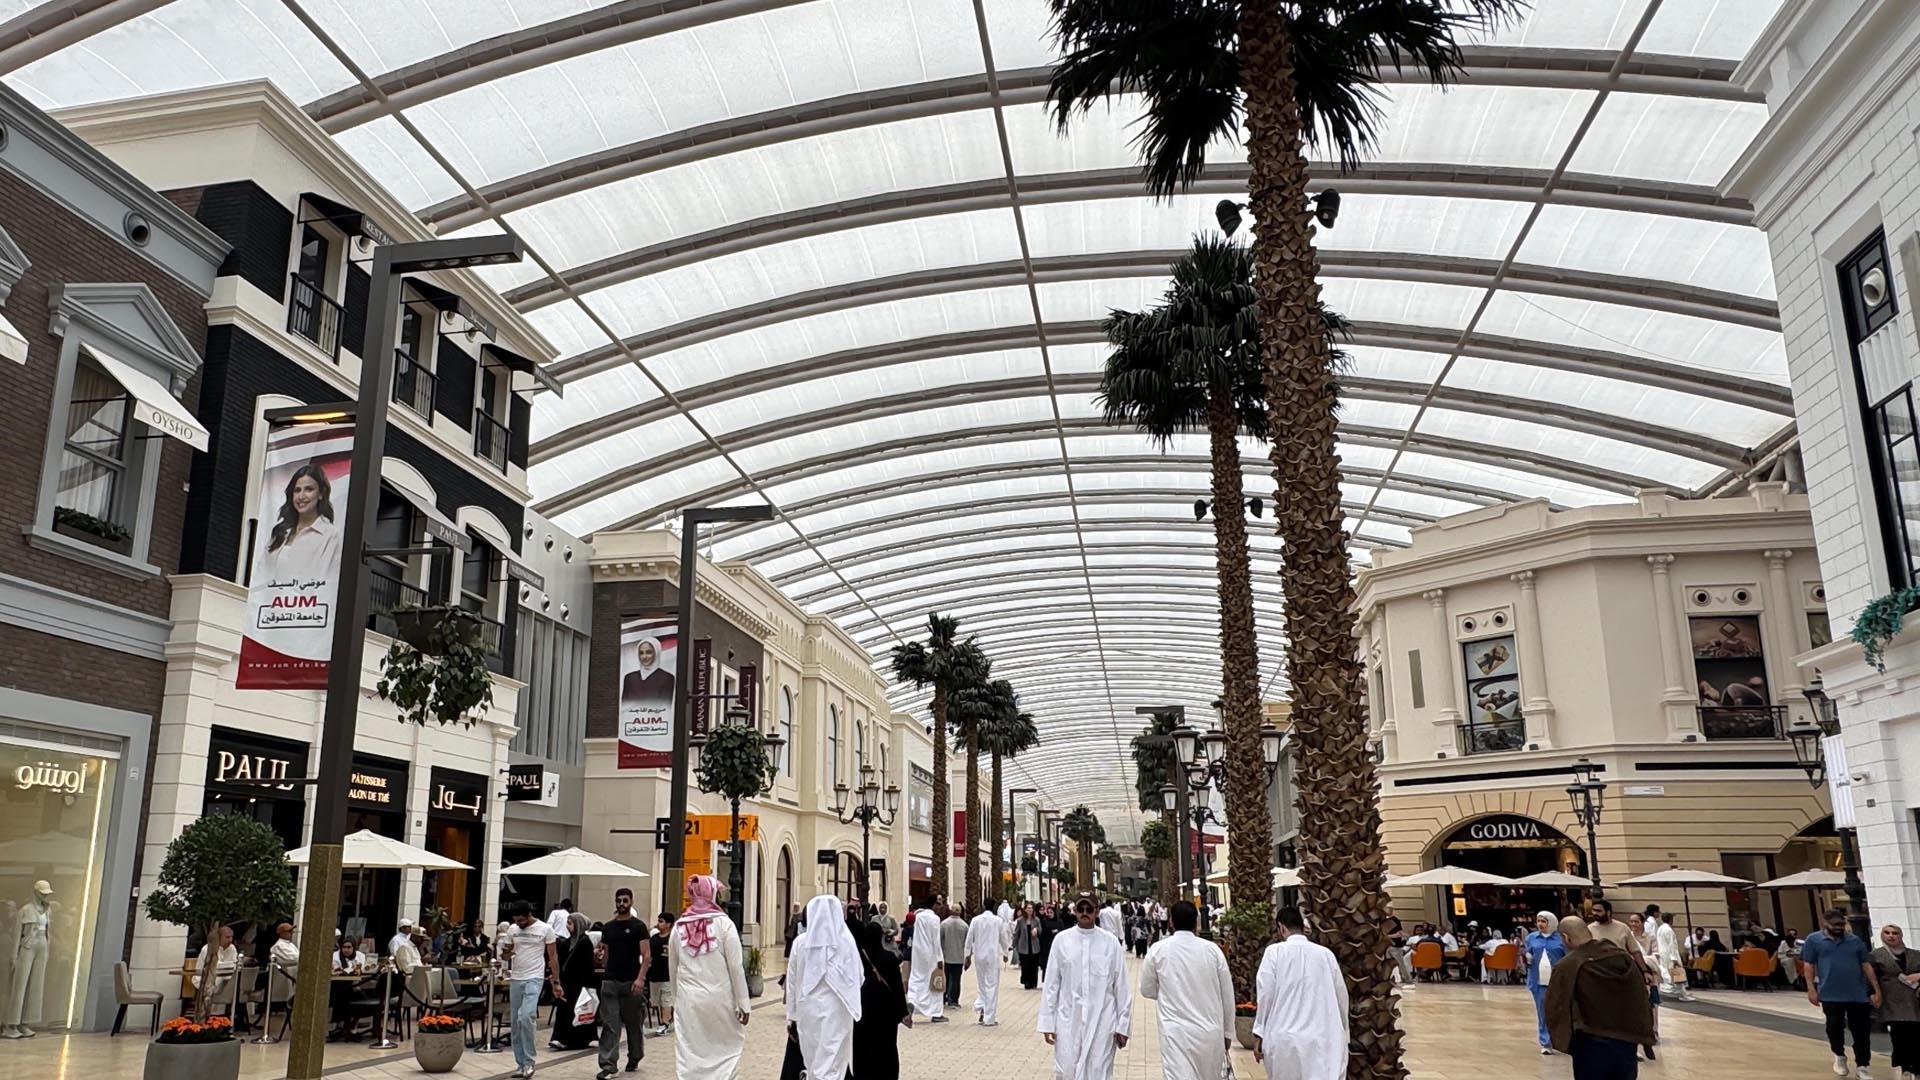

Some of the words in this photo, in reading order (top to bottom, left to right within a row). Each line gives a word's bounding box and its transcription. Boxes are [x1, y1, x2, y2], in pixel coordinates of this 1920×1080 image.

[152, 411, 193, 440] OYSHO
[440, 525, 462, 546] PAUL
[271, 595, 317, 608] AUM
[261, 612, 296, 624] المتفوقين
[296, 612, 324, 623] جامعة
[698, 648, 707, 690] REPUBLIC
[696, 691, 705, 729] BANANA
[632, 716, 662, 725] AUM
[214, 750, 295, 791] PAUL
[510, 774, 540, 786] PAUL
[347, 788, 367, 800] ALON
[367, 791, 377, 801] DE
[684, 820, 700, 834] 21
[1470, 823, 1541, 839] GODIVA
